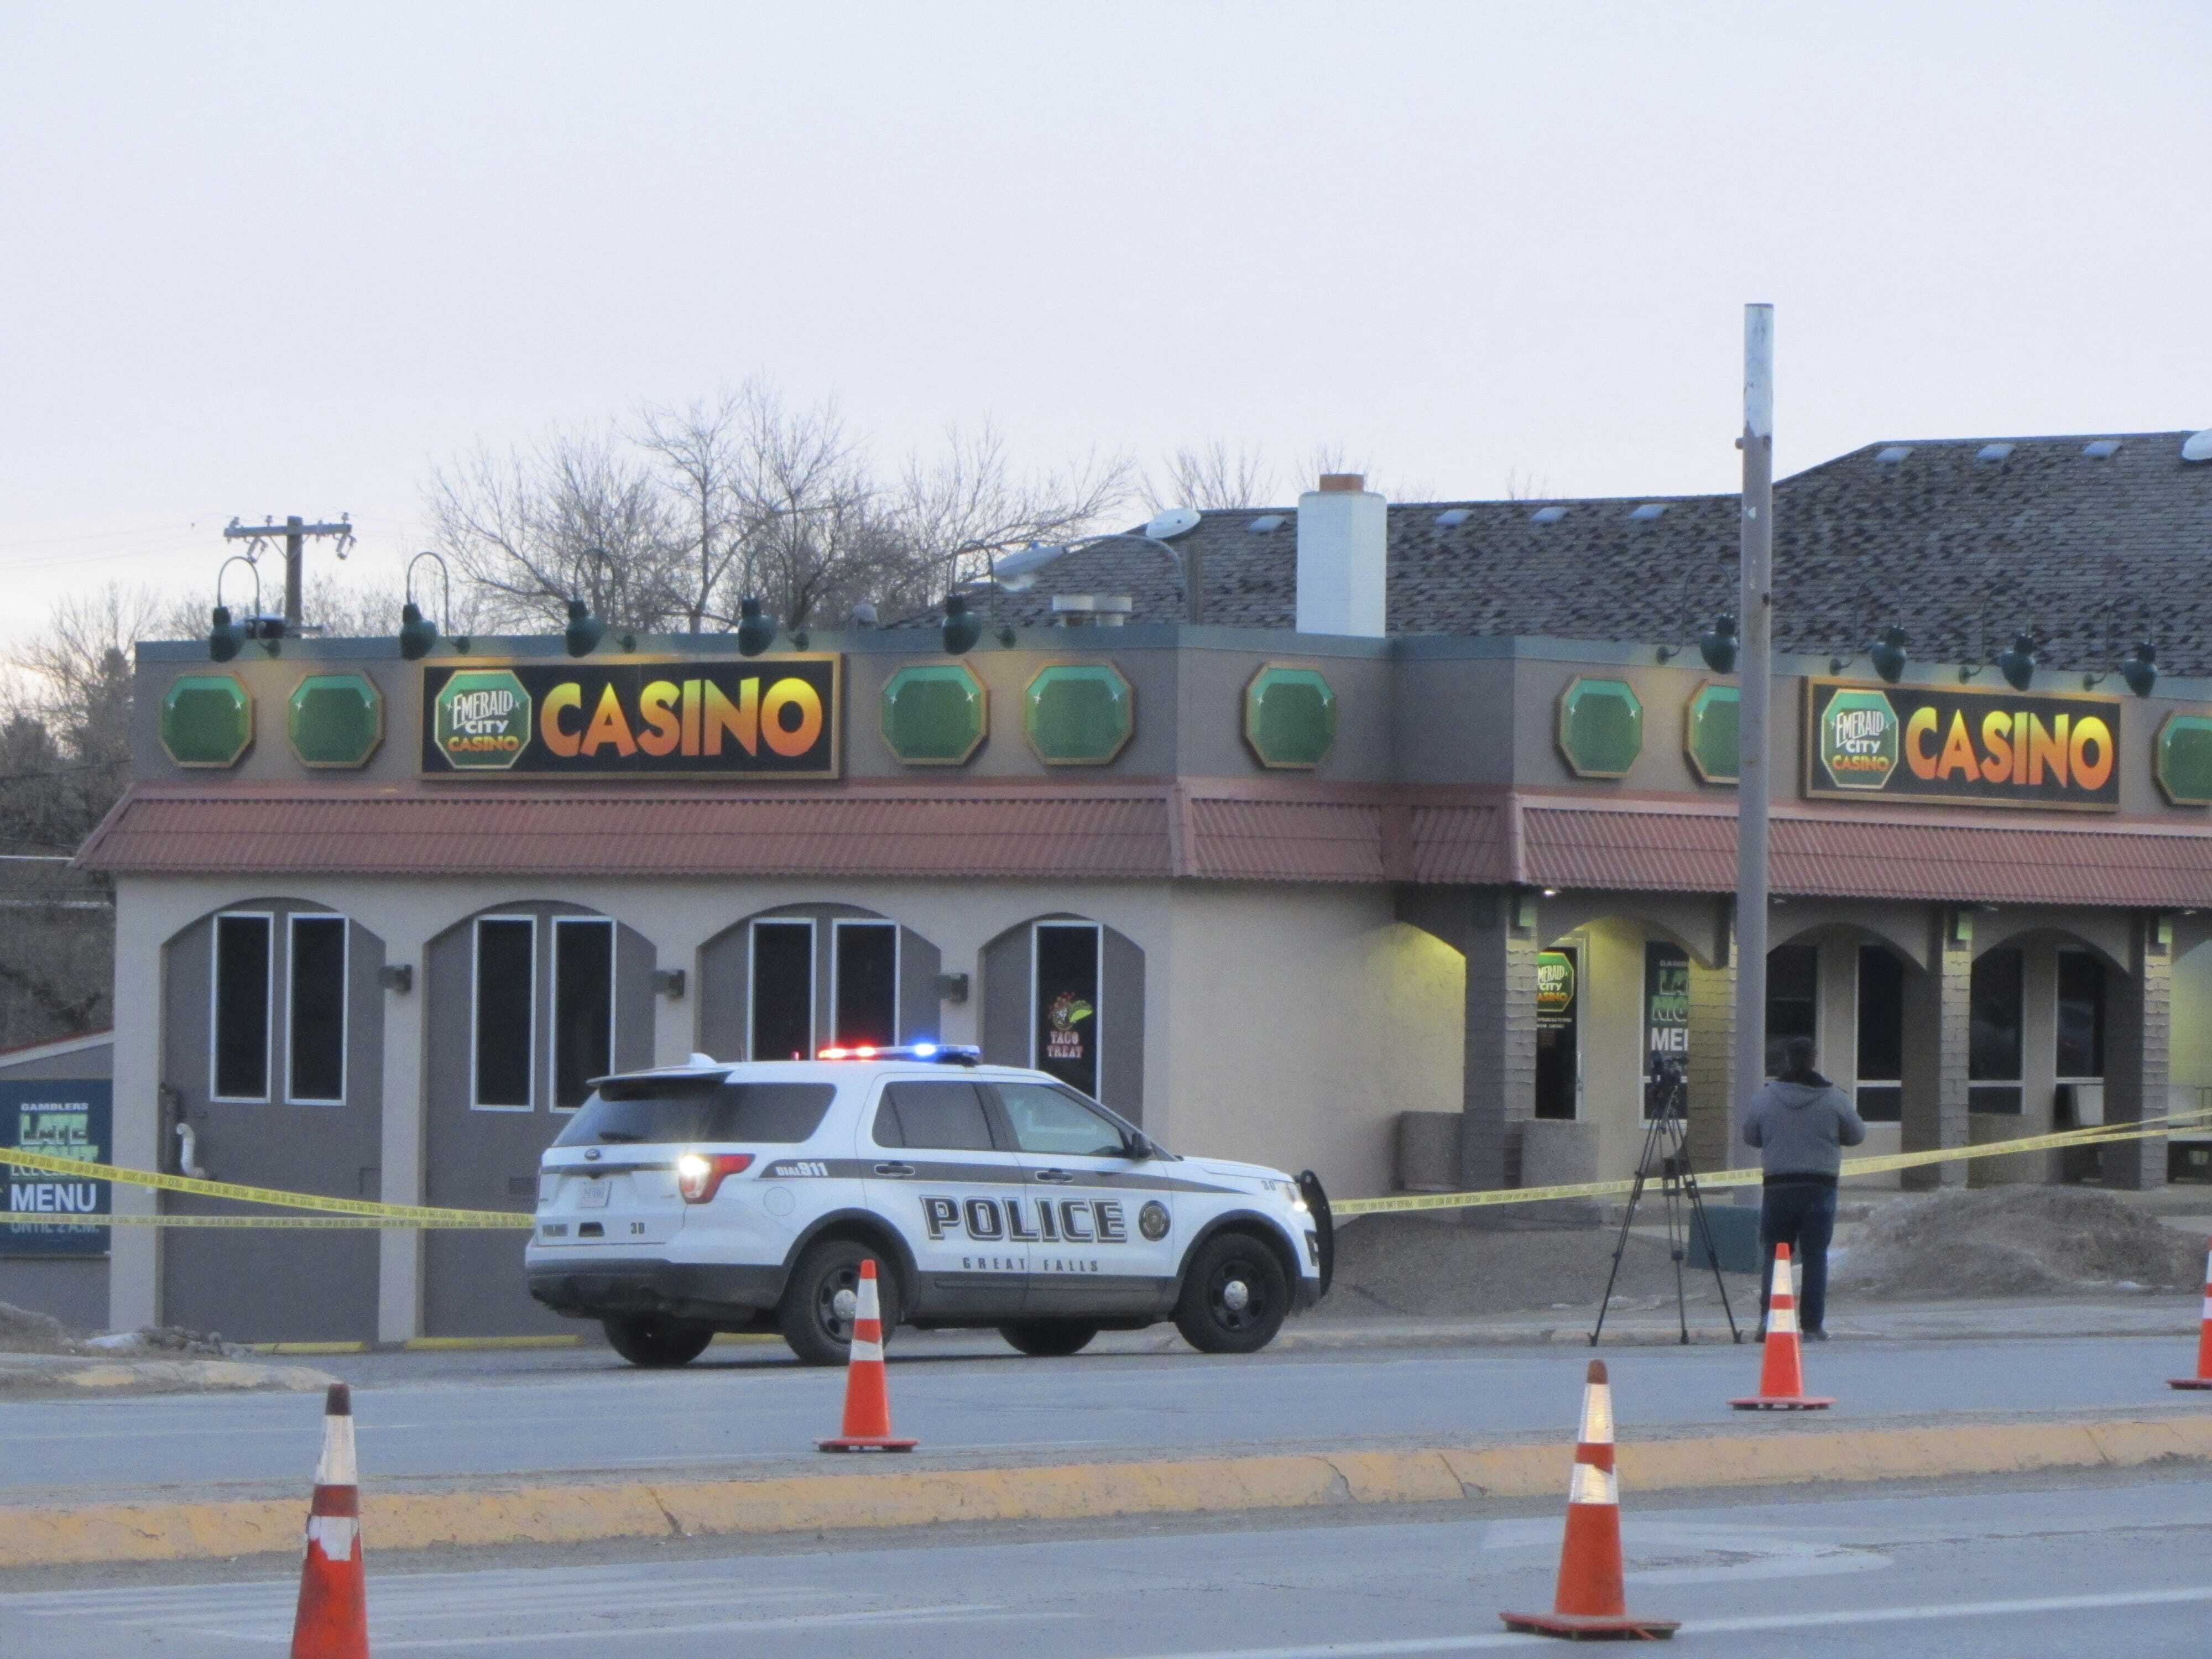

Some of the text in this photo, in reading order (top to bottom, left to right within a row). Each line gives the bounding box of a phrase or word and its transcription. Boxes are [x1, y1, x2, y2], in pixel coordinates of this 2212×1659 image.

[453, 690, 513, 730] EMERALD
[540, 677, 822, 757] CASINO
[465, 719, 509, 734] CITY
[1835, 711, 1884, 748] EMERALD
[448, 735, 519, 752] CASINO
[1845, 739, 1881, 753] CITY
[1906, 706, 2114, 791] CASINO
[1832, 755, 1889, 770] CASINO
[1537, 965, 1565, 984] MERALD
[1540, 983, 1562, 991] CITY
[1537, 992, 1568, 1001] ASINO
[1050, 1031, 1079, 1044] TACO
[1047, 1045, 1083, 1057] TREAT
[21, 1103, 89, 1112] GAMBLERS
[797, 1162, 828, 1176] 911
[11, 1184, 96, 1212] MENU
[920, 1194, 1127, 1243] POLICE
[963, 1256, 1098, 1272] GREAT FALLS
